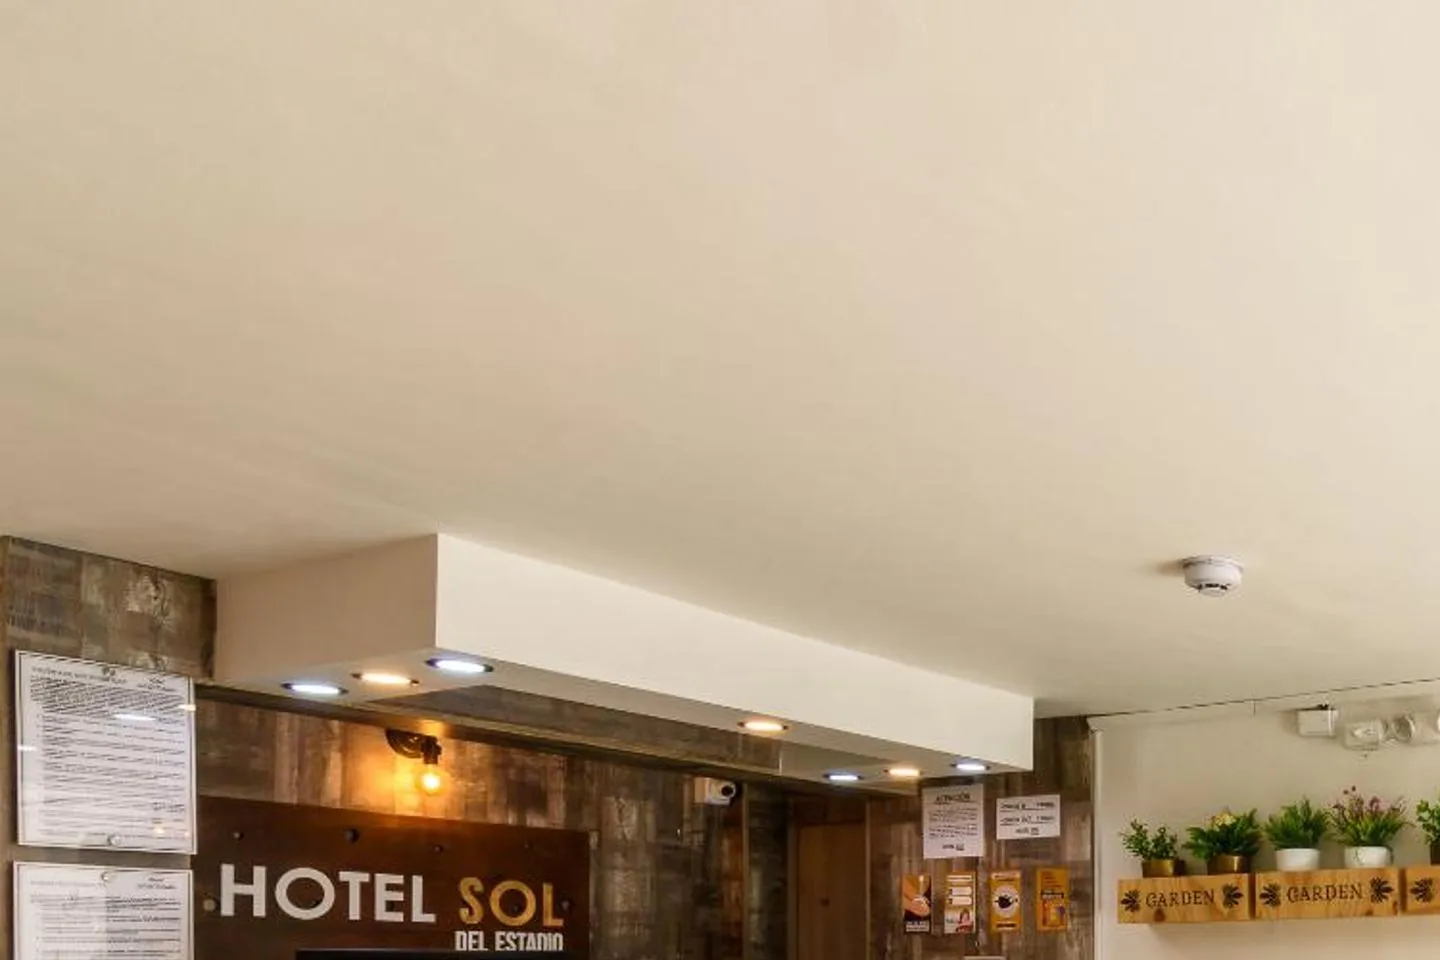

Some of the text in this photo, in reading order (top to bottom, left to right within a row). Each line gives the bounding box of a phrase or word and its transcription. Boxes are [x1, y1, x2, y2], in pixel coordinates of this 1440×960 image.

[220, 863, 564, 927] HOTEL SOL
[1145, 889, 1215, 908] GARDEN
[1286, 883, 1363, 903] GARDEN
[454, 930, 564, 951] DEL ESTADIO
